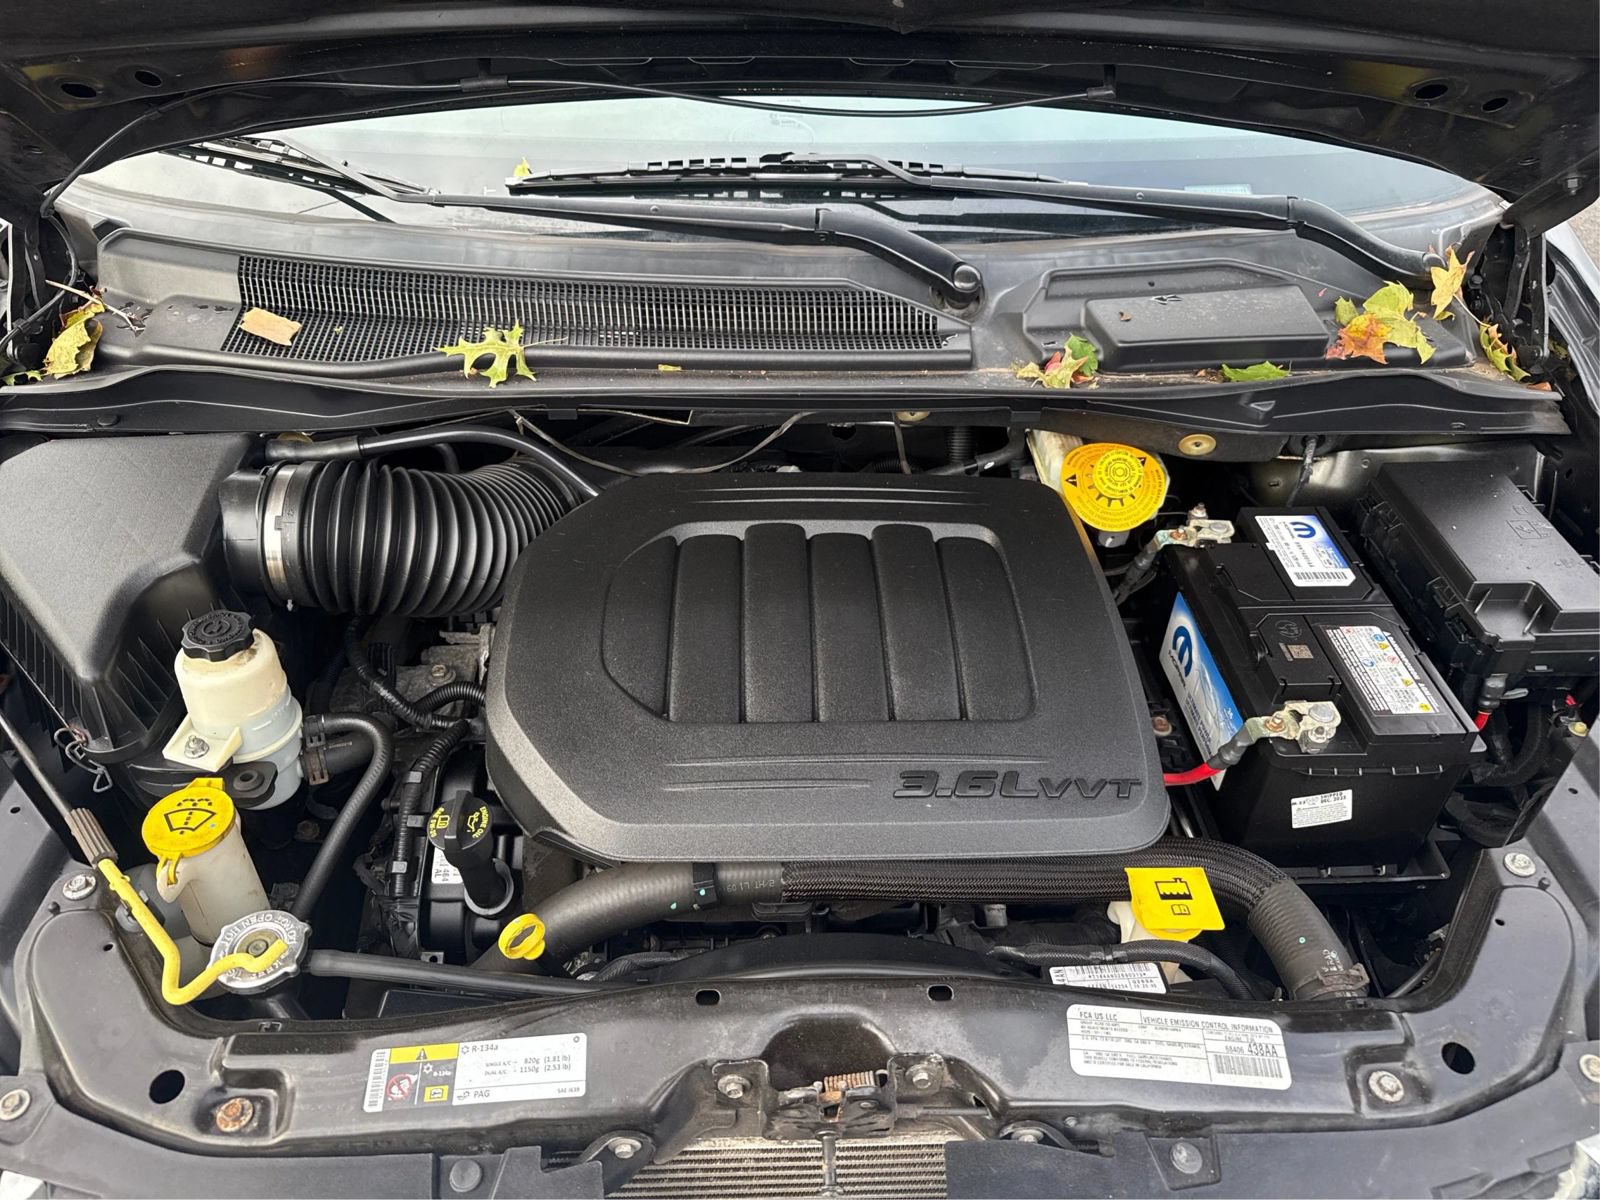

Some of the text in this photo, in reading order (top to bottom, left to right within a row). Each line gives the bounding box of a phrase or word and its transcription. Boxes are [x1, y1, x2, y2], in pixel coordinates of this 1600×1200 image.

[892, 769, 1143, 799] 3.6L VVT
[472, 806, 489, 839] ENGINE OIL
[241, 913, 273, 929] OPEN
[220, 925, 241, 945] HOT
[1079, 1011, 1118, 1021] FCA US LLC
[1142, 1016, 1274, 1033] VEHICLE EMISSION CONTROL INFORMATION
[471, 1043, 499, 1054] R-134a
[1247, 1042, 1279, 1057] 438AA
[524, 1057, 541, 1065] 820g
[473, 1089, 491, 1098] PAG
